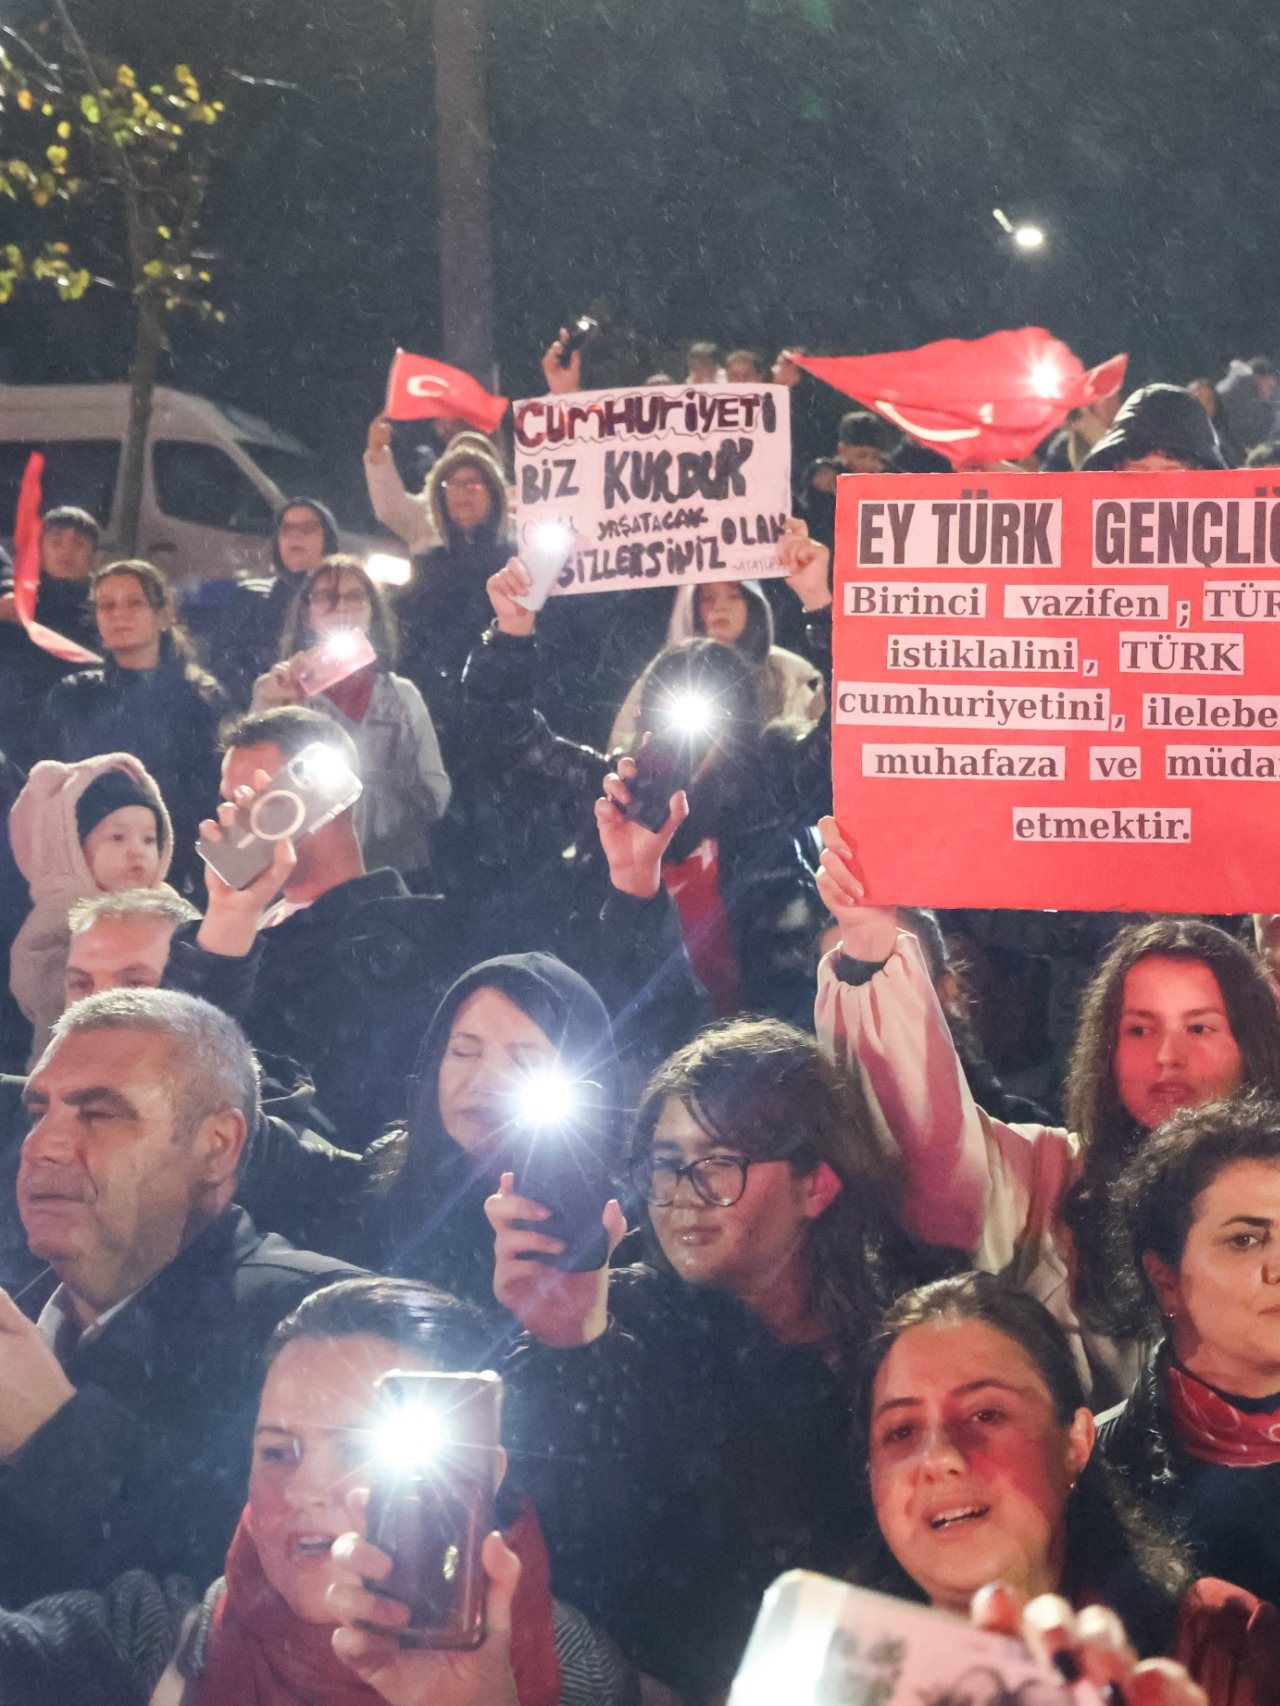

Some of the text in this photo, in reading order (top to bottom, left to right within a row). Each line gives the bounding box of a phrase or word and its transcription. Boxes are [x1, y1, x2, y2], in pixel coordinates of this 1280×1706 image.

[859, 503, 915, 564] EY
[931, 489, 1054, 565] TÜRK
[851, 586, 980, 616] Birinci
[1121, 634, 1241, 672] TÜRK
[875, 746, 1058, 778] muhafaza
[1095, 757, 1138, 778] ve
[1015, 809, 1190, 840] etmektir.
